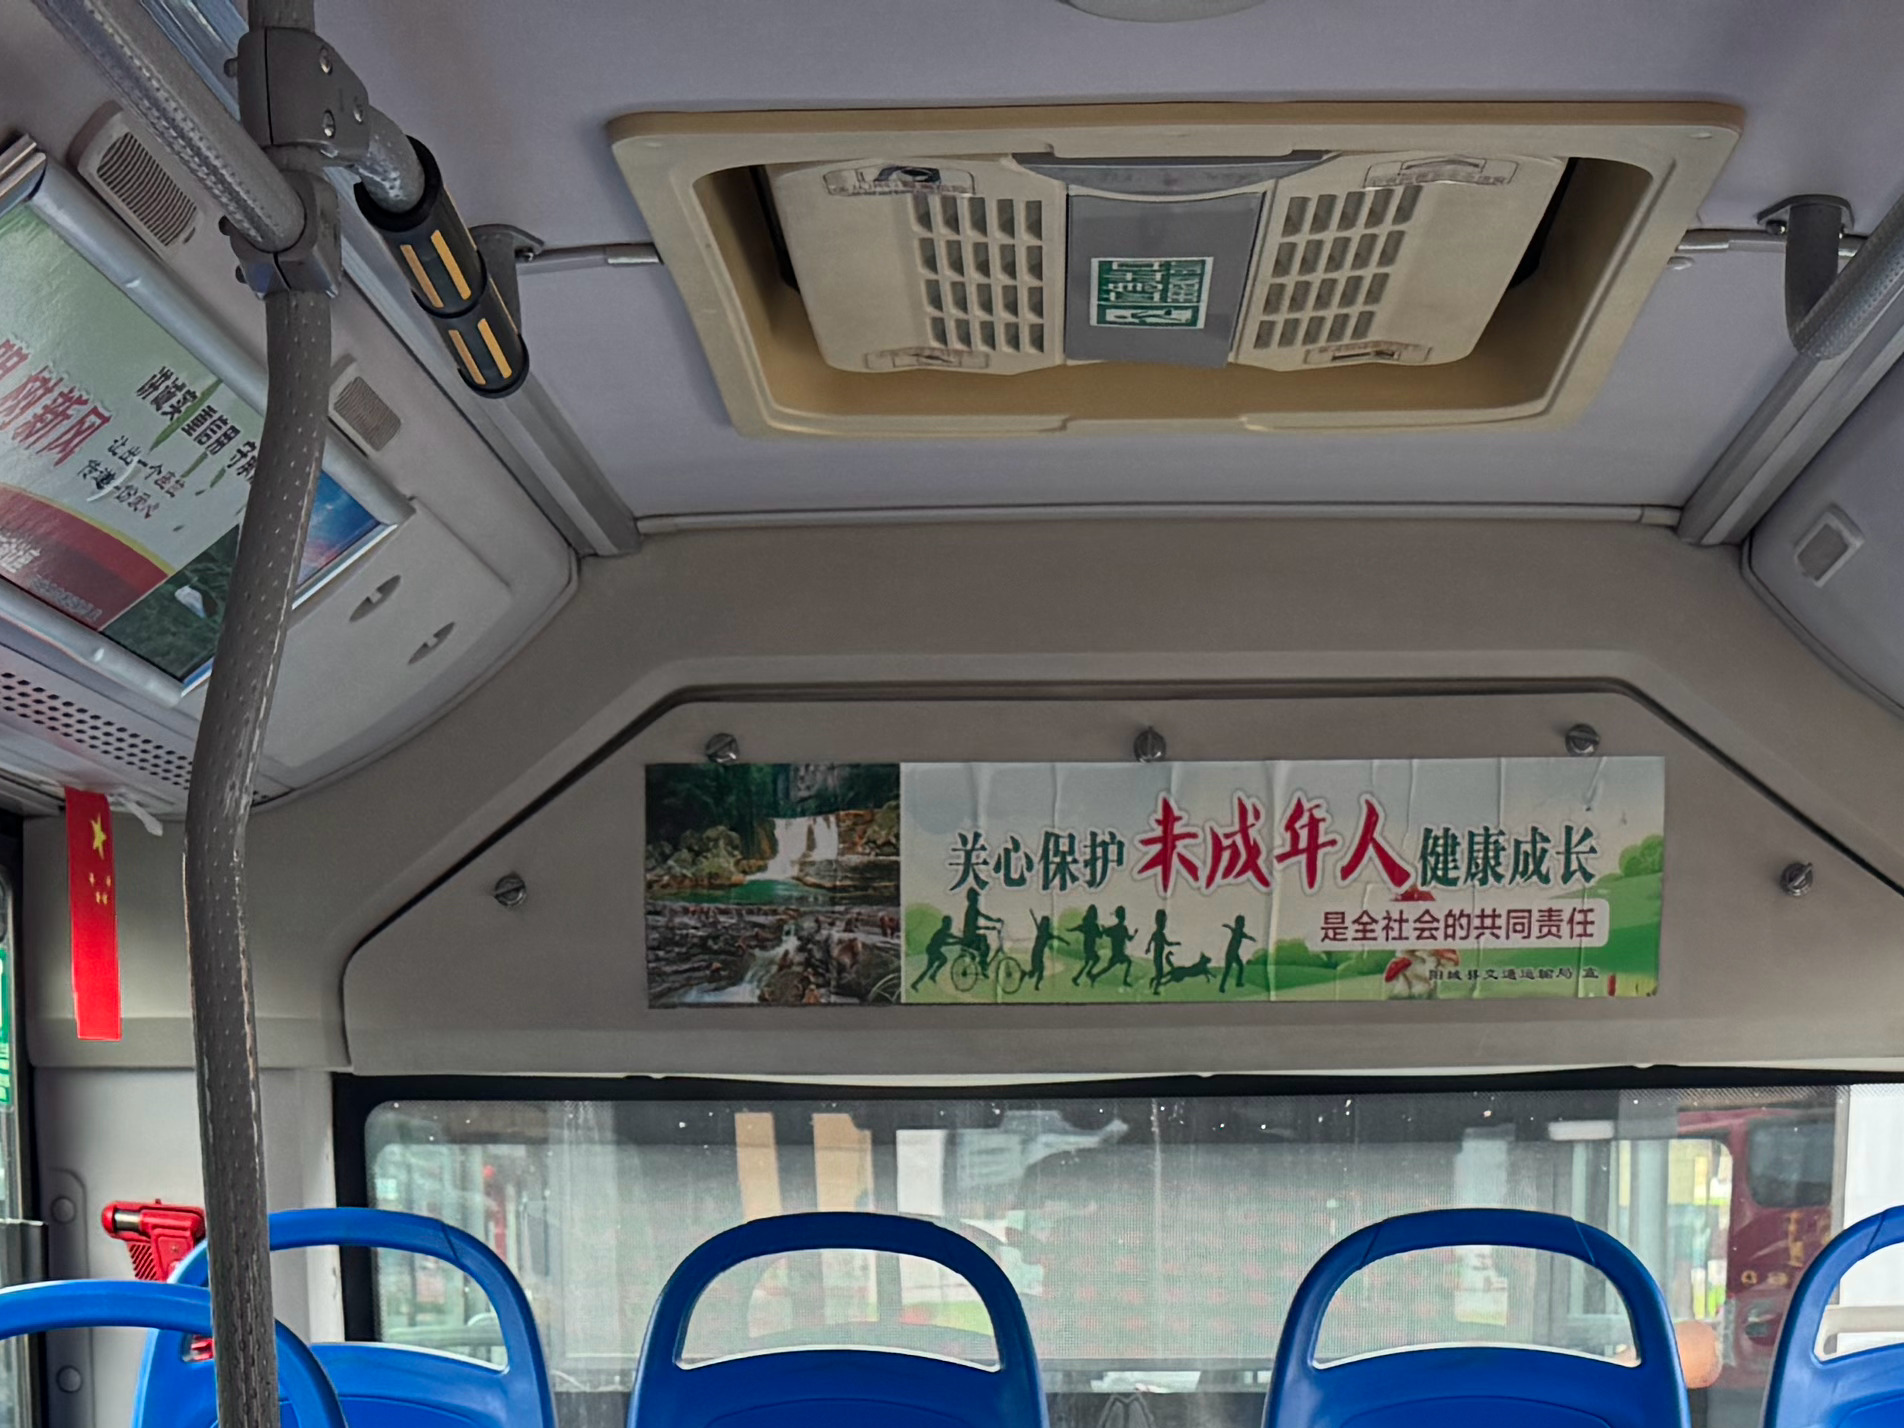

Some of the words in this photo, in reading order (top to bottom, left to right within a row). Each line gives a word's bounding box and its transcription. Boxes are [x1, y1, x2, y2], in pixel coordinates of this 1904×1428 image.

[1319, 908, 1596, 944] 是全社会的共同责任
